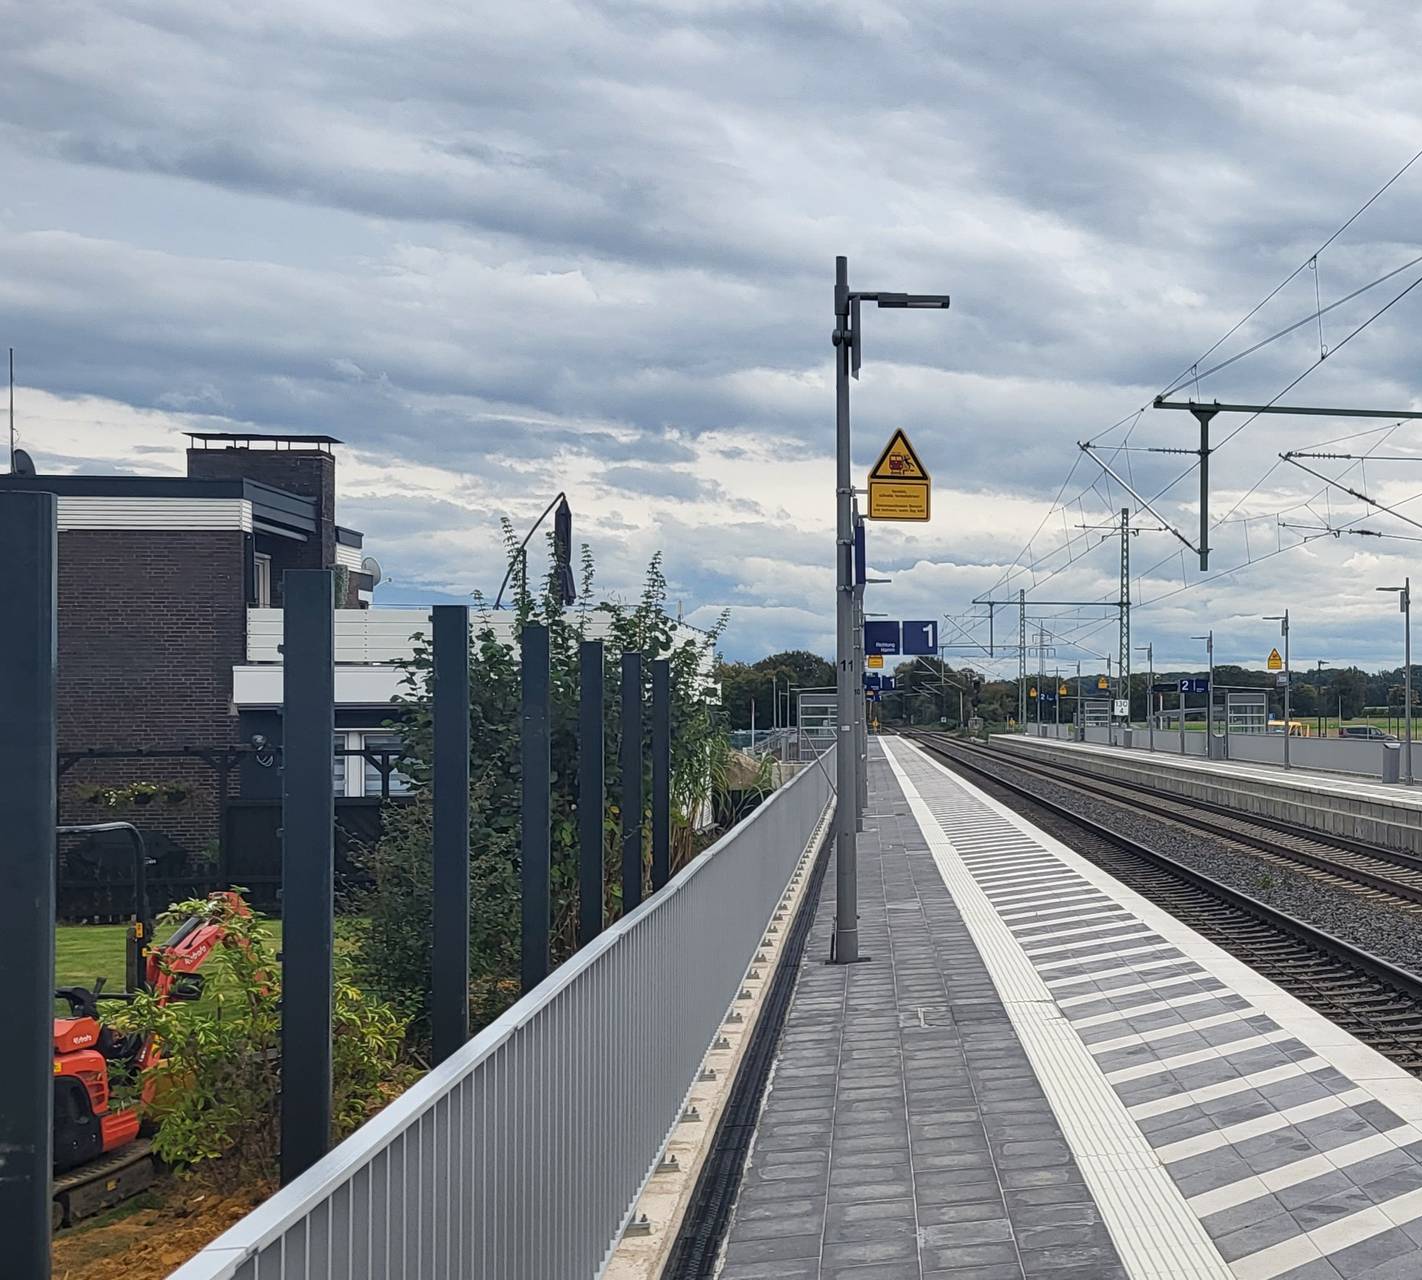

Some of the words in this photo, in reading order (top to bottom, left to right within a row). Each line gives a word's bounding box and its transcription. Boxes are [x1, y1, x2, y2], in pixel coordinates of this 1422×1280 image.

[922, 623, 933, 648] 1
[840, 659, 854, 672] 11
[1181, 680, 1189, 691] 2
